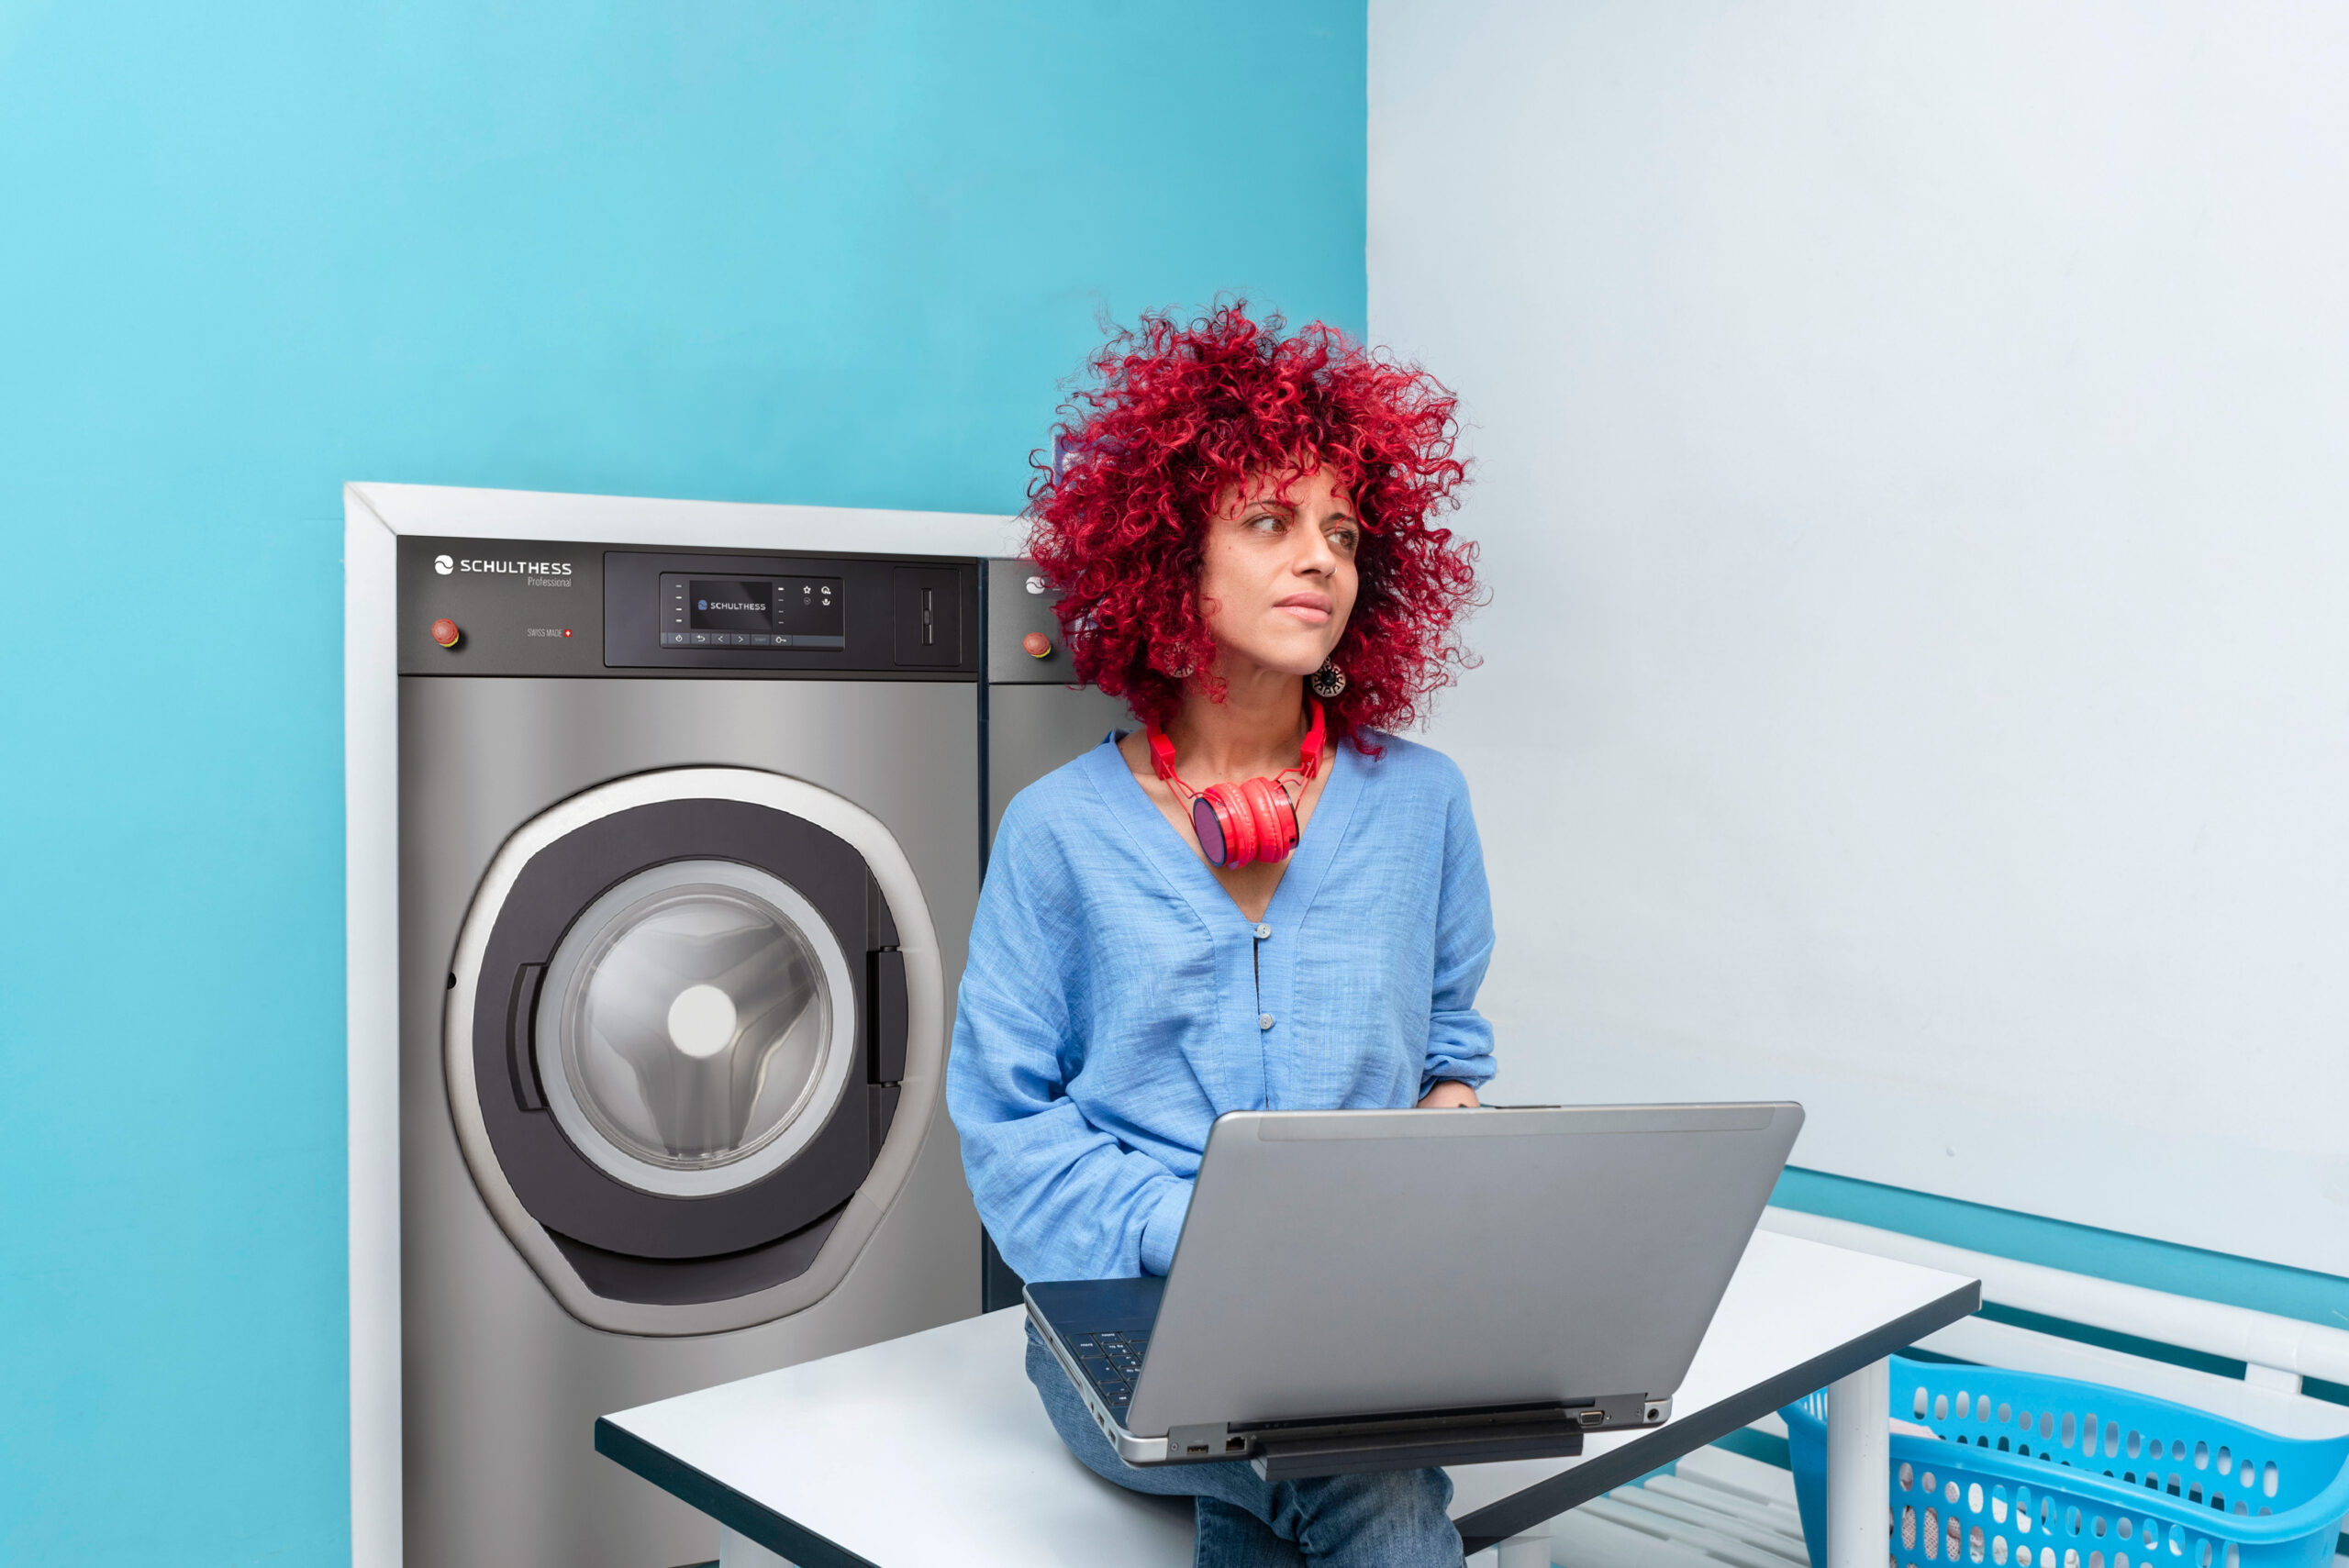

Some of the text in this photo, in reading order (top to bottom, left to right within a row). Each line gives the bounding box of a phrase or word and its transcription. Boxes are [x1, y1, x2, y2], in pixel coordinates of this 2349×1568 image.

[460, 560, 573, 575] SCHULTHESS
[528, 576, 572, 588] Professional
[710, 602, 766, 611] SCHULTHESS
